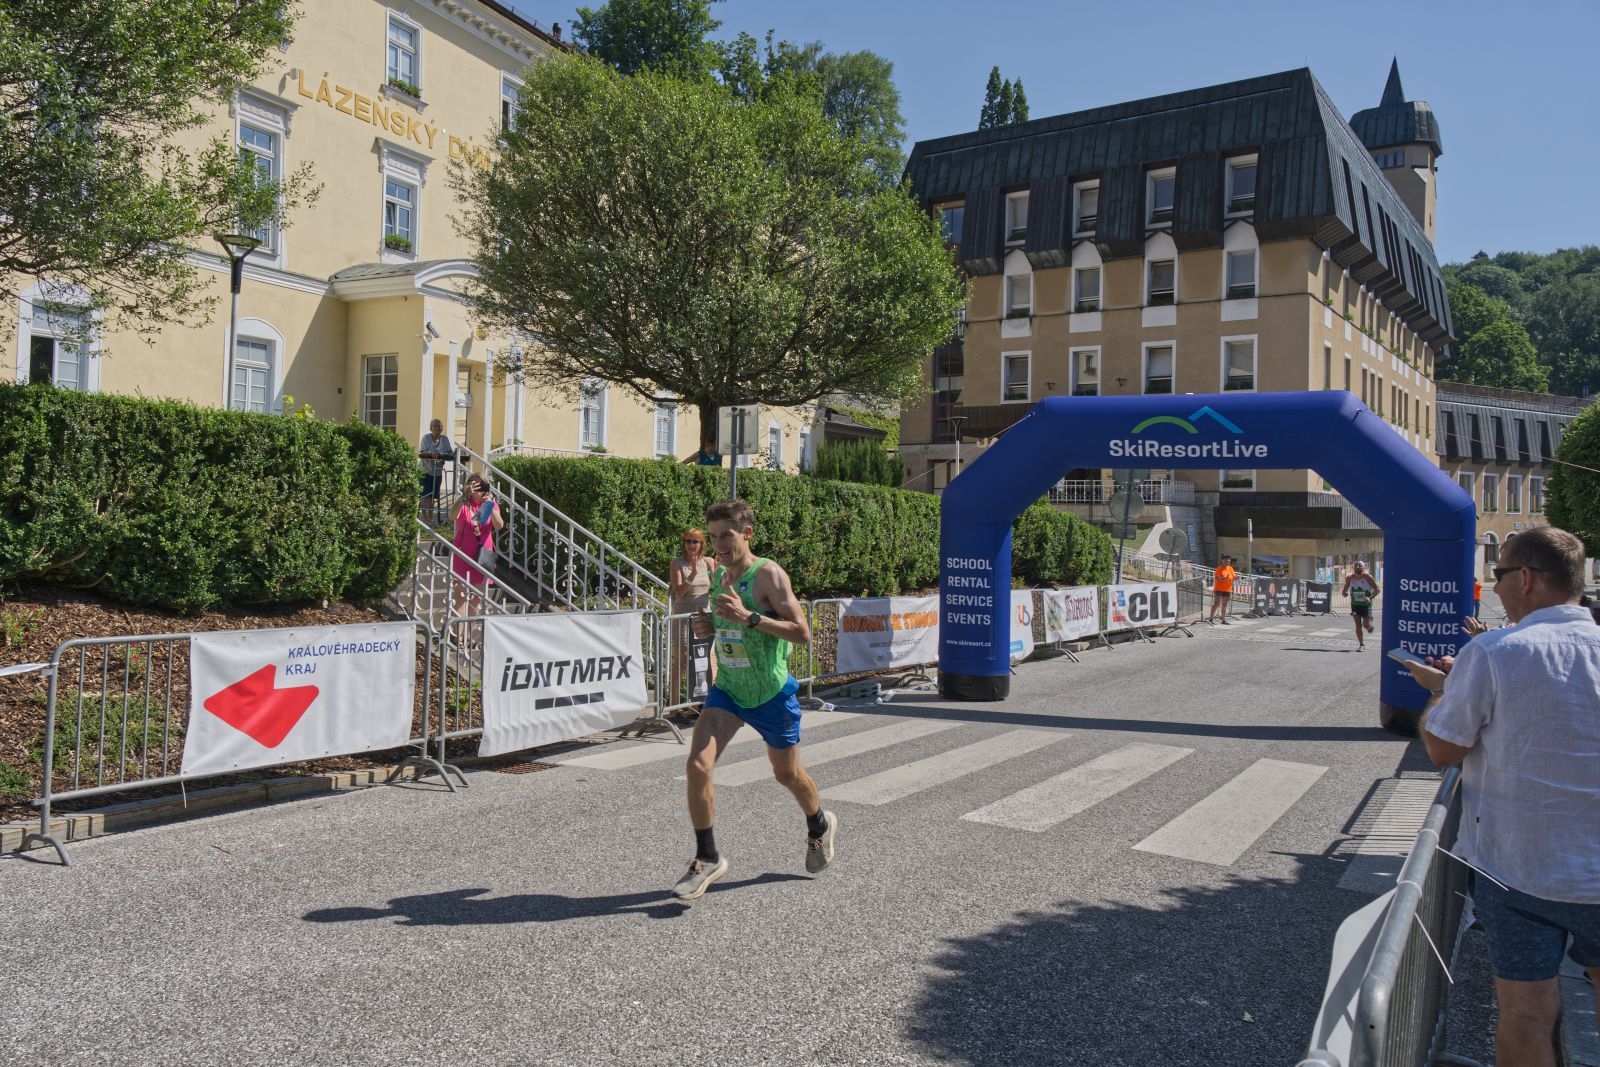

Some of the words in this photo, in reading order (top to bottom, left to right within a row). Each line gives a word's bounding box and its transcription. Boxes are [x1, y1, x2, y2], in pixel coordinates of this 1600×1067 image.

[298, 69, 438, 149] LÁZEŇSKÝ
[1109, 439, 1268, 458] SkiResortLive
[946, 557, 993, 570] SCHOOL
[947, 576, 991, 589] RENTAL
[1400, 579, 1459, 593] SCHOOL
[946, 594, 993, 607] SERVICE
[1128, 586, 1175, 622] CÍL
[1401, 599, 1457, 614] RENTAL
[947, 612, 991, 625] EVENTS
[1398, 619, 1459, 635] SERVICE
[288, 640, 400, 659] KRÁLOVÉHRADECKÝ
[1400, 640, 1456, 656] EVENTS
[285, 662, 317, 676] KRAJ
